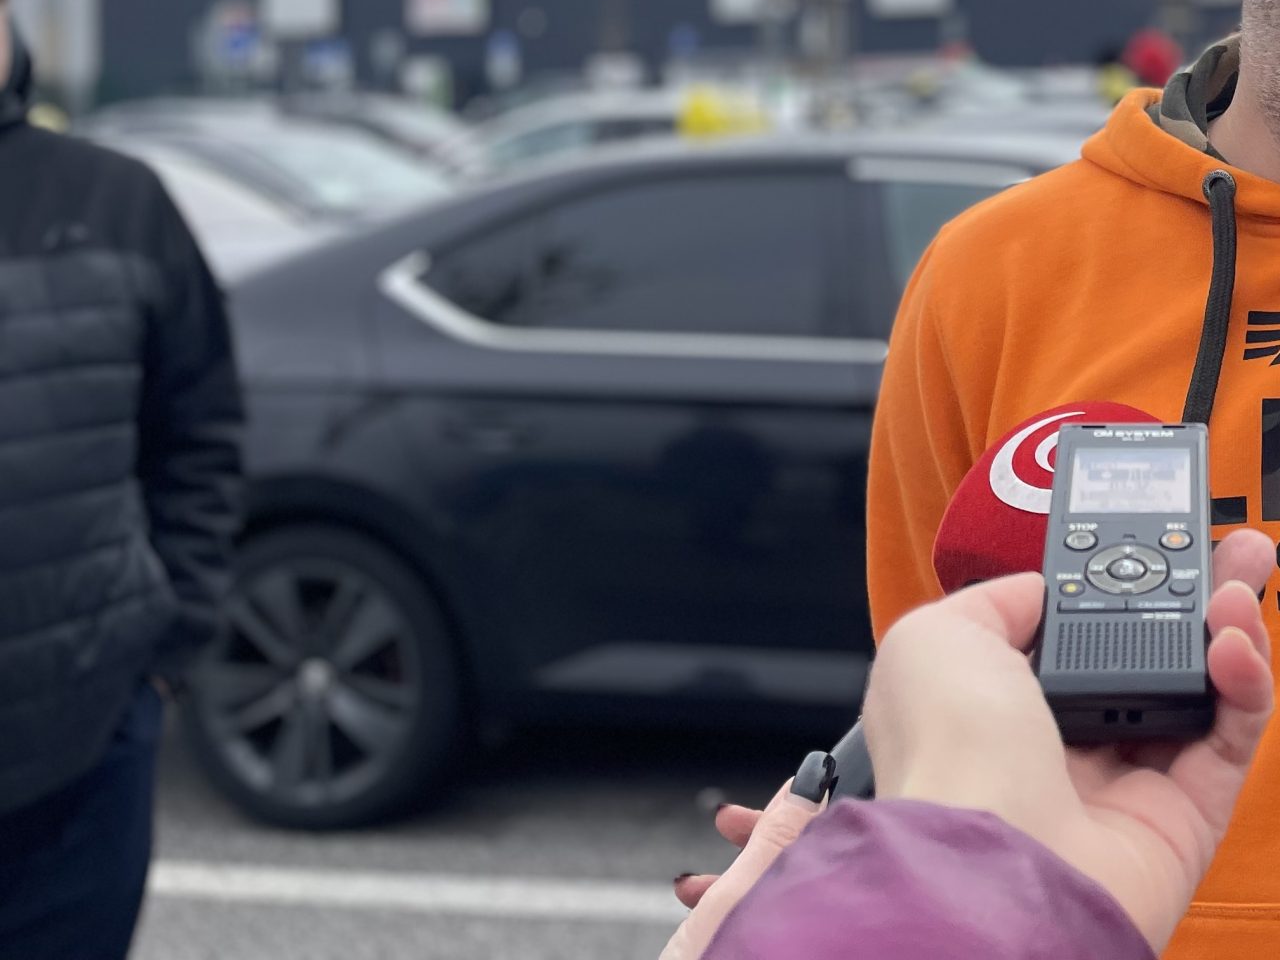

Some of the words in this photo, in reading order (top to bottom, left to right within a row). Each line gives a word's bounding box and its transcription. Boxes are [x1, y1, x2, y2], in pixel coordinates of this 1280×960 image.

[1115, 430, 1174, 438] SYSTEM
[1068, 522, 1098, 531] STOP
[1166, 522, 1188, 530] REC
